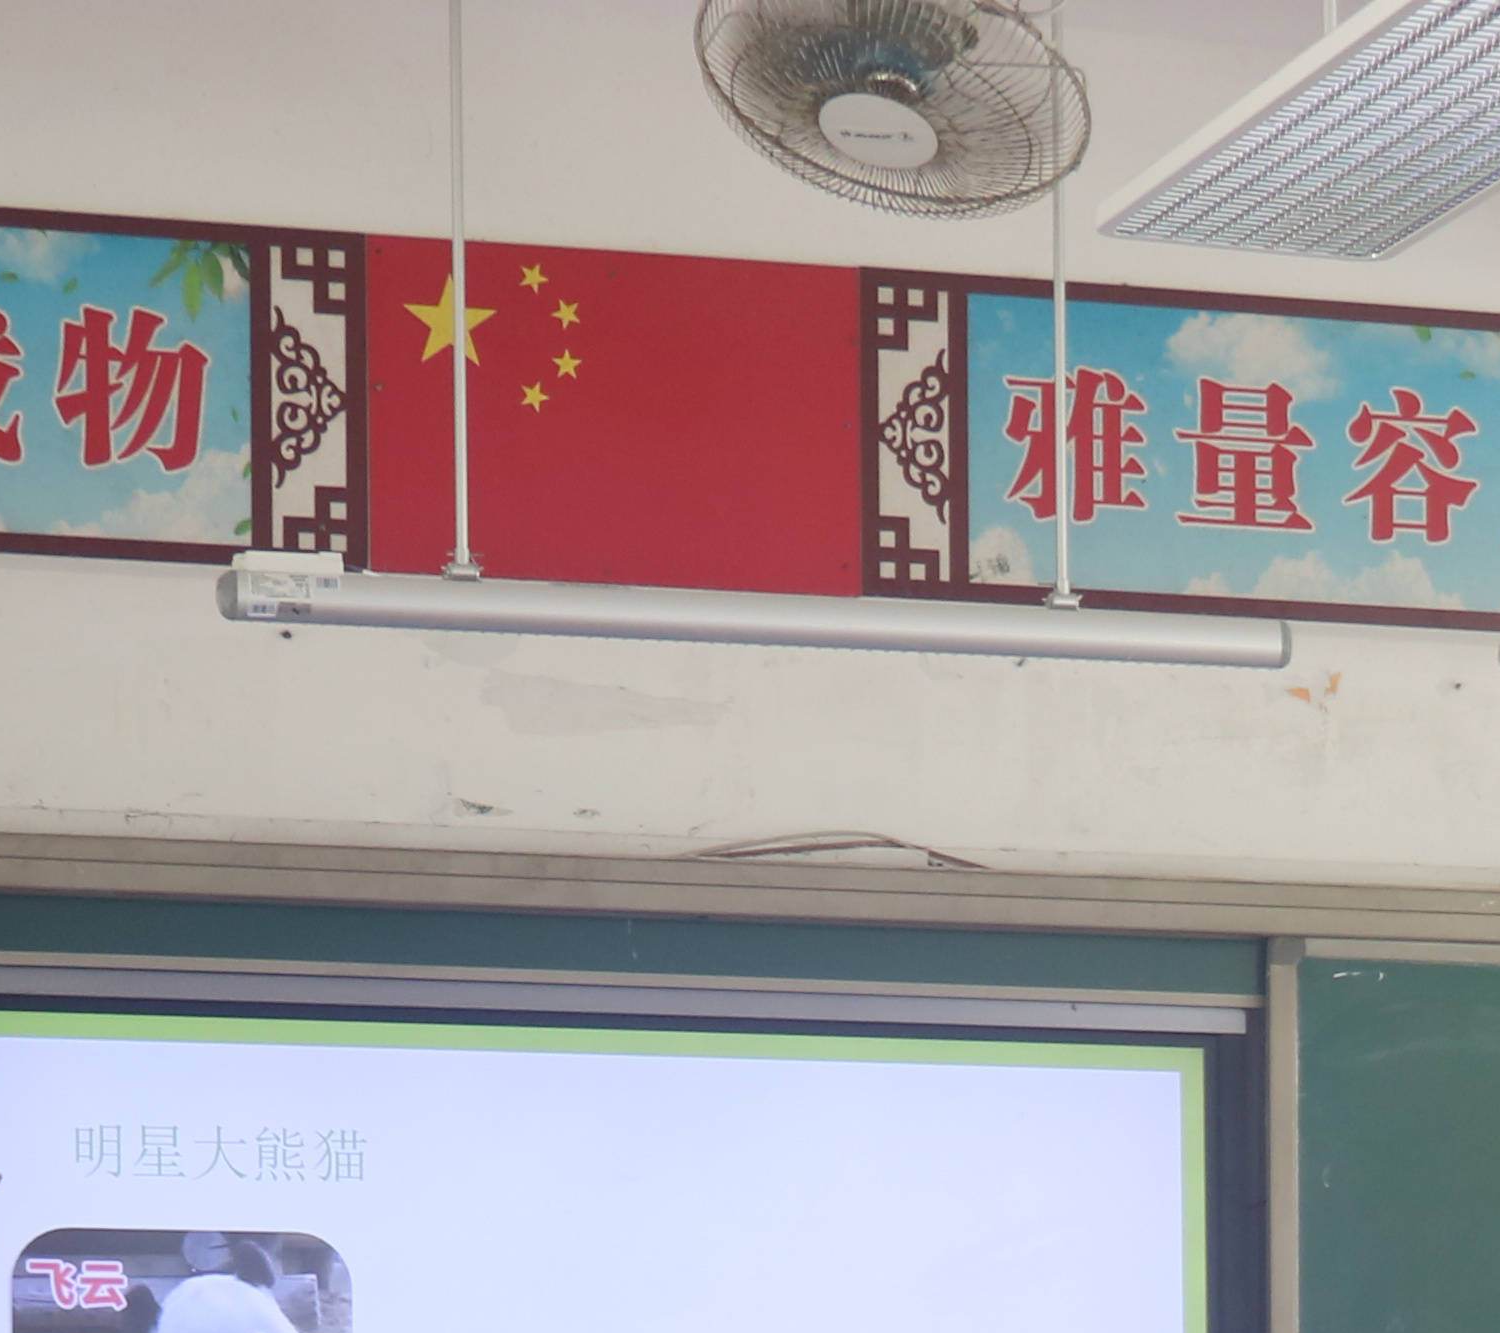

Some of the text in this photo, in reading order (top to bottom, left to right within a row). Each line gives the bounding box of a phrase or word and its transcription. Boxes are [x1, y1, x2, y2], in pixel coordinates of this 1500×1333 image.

[73, 1123, 369, 1183] 明星大熊猫
[26, 1258, 128, 1312] 飞云
